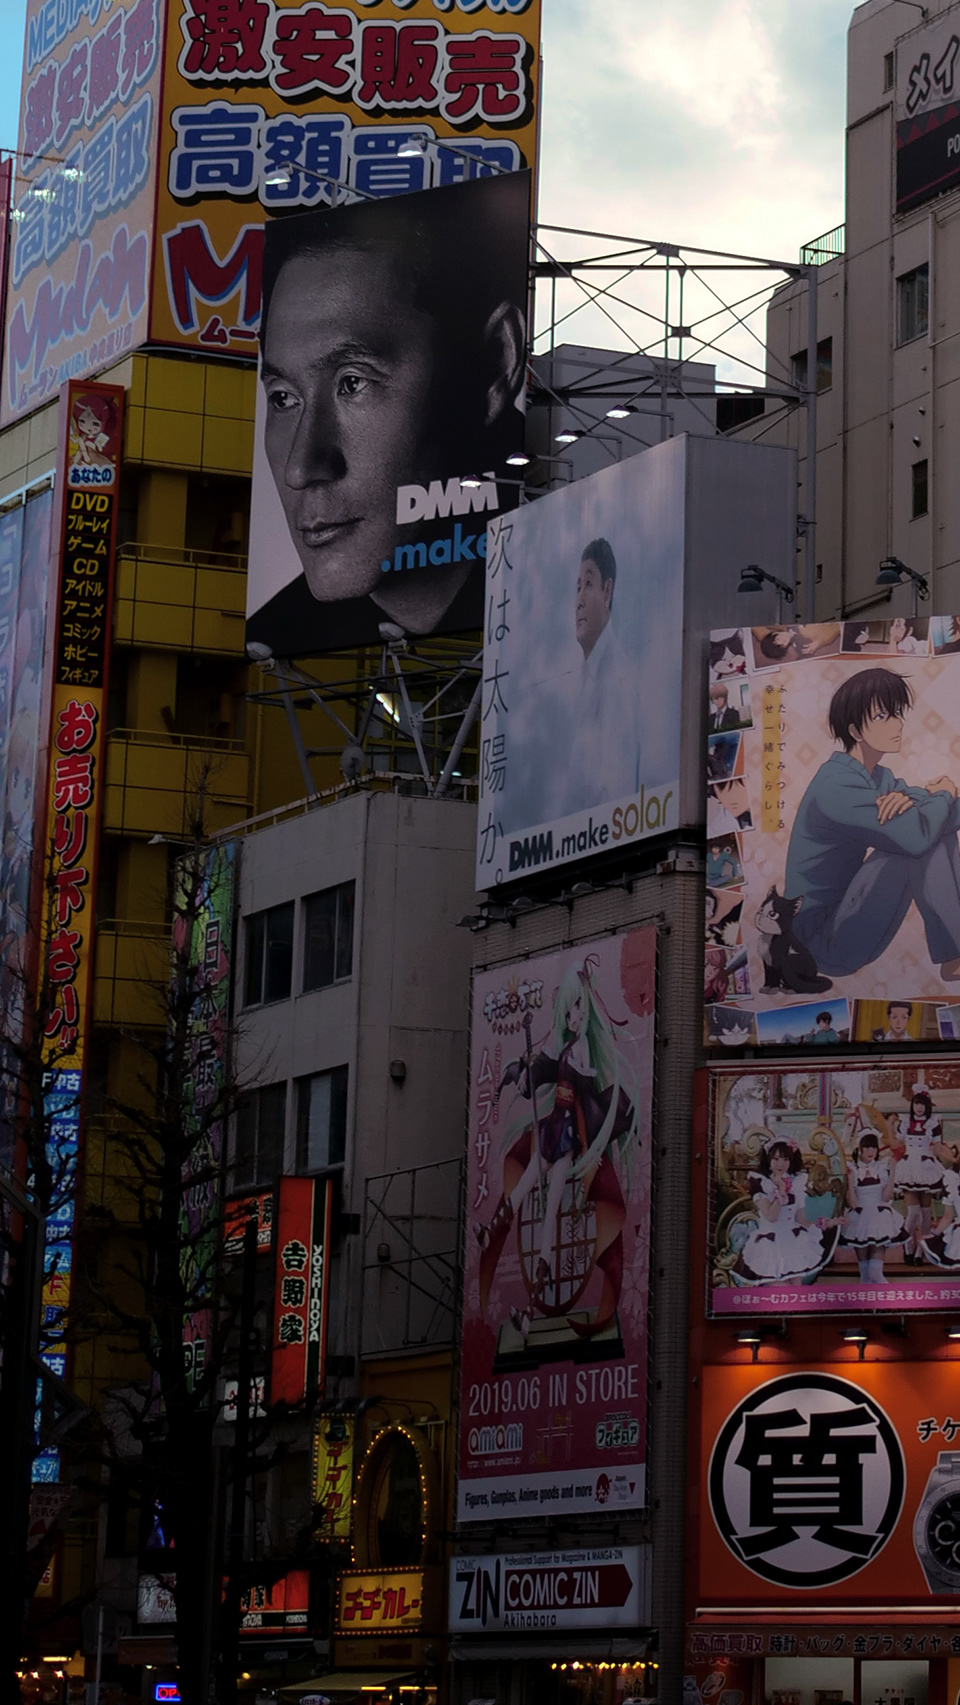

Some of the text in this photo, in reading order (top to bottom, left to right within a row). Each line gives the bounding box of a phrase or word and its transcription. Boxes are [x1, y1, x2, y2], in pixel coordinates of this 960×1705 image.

[71, 467, 112, 485] あなたの
[70, 492, 110, 513] DVD
[396, 471, 499, 525] DMM
[67, 513, 110, 535] ブルーレイ
[66, 536, 108, 556] ゲーム
[72, 558, 100, 576] CD
[64, 578, 105, 599] アイドル
[62, 599, 105, 619] アニメ
[62, 623, 102, 642] コミック
[63, 644, 100, 663] ホビー
[612, 783, 673, 841] solar
[475, 1047, 494, 1209] ムラサメ
[280, 1239, 309, 1344] 吉野家
[469, 1364, 639, 1417] 2019.06 IN STORE
[596, 1423, 639, 1448] フィギュア
[575, 1484, 593, 1497] more
[456, 1558, 500, 1627] ZIN
[506, 1569, 600, 1608] COMIC ZIN
[504, 1612, 557, 1628] Akihabara
[690, 1633, 763, 1654] 高価買取
